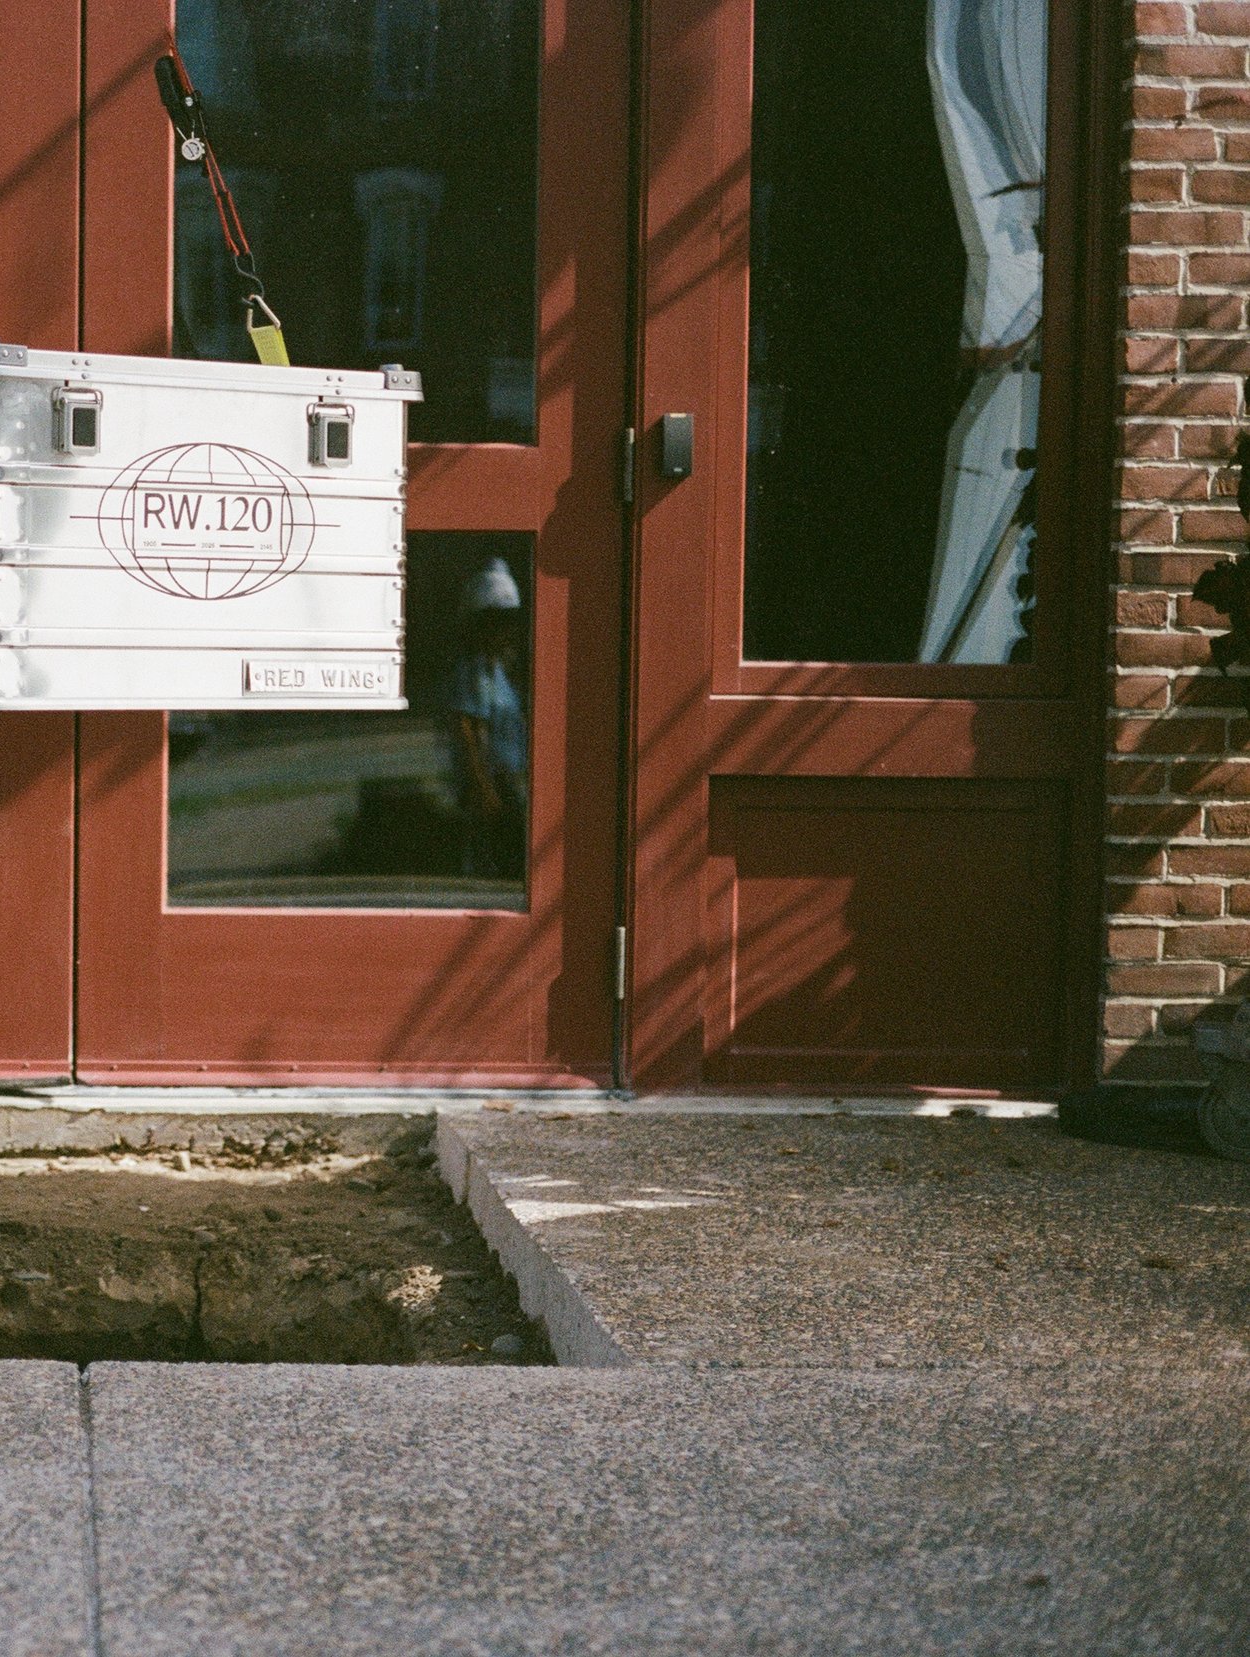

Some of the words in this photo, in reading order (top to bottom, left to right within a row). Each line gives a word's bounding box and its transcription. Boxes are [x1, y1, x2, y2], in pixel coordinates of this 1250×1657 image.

[143, 492, 273, 533] RW.120
[264, 668, 305, 688] RED
[320, 669, 375, 689] WING
